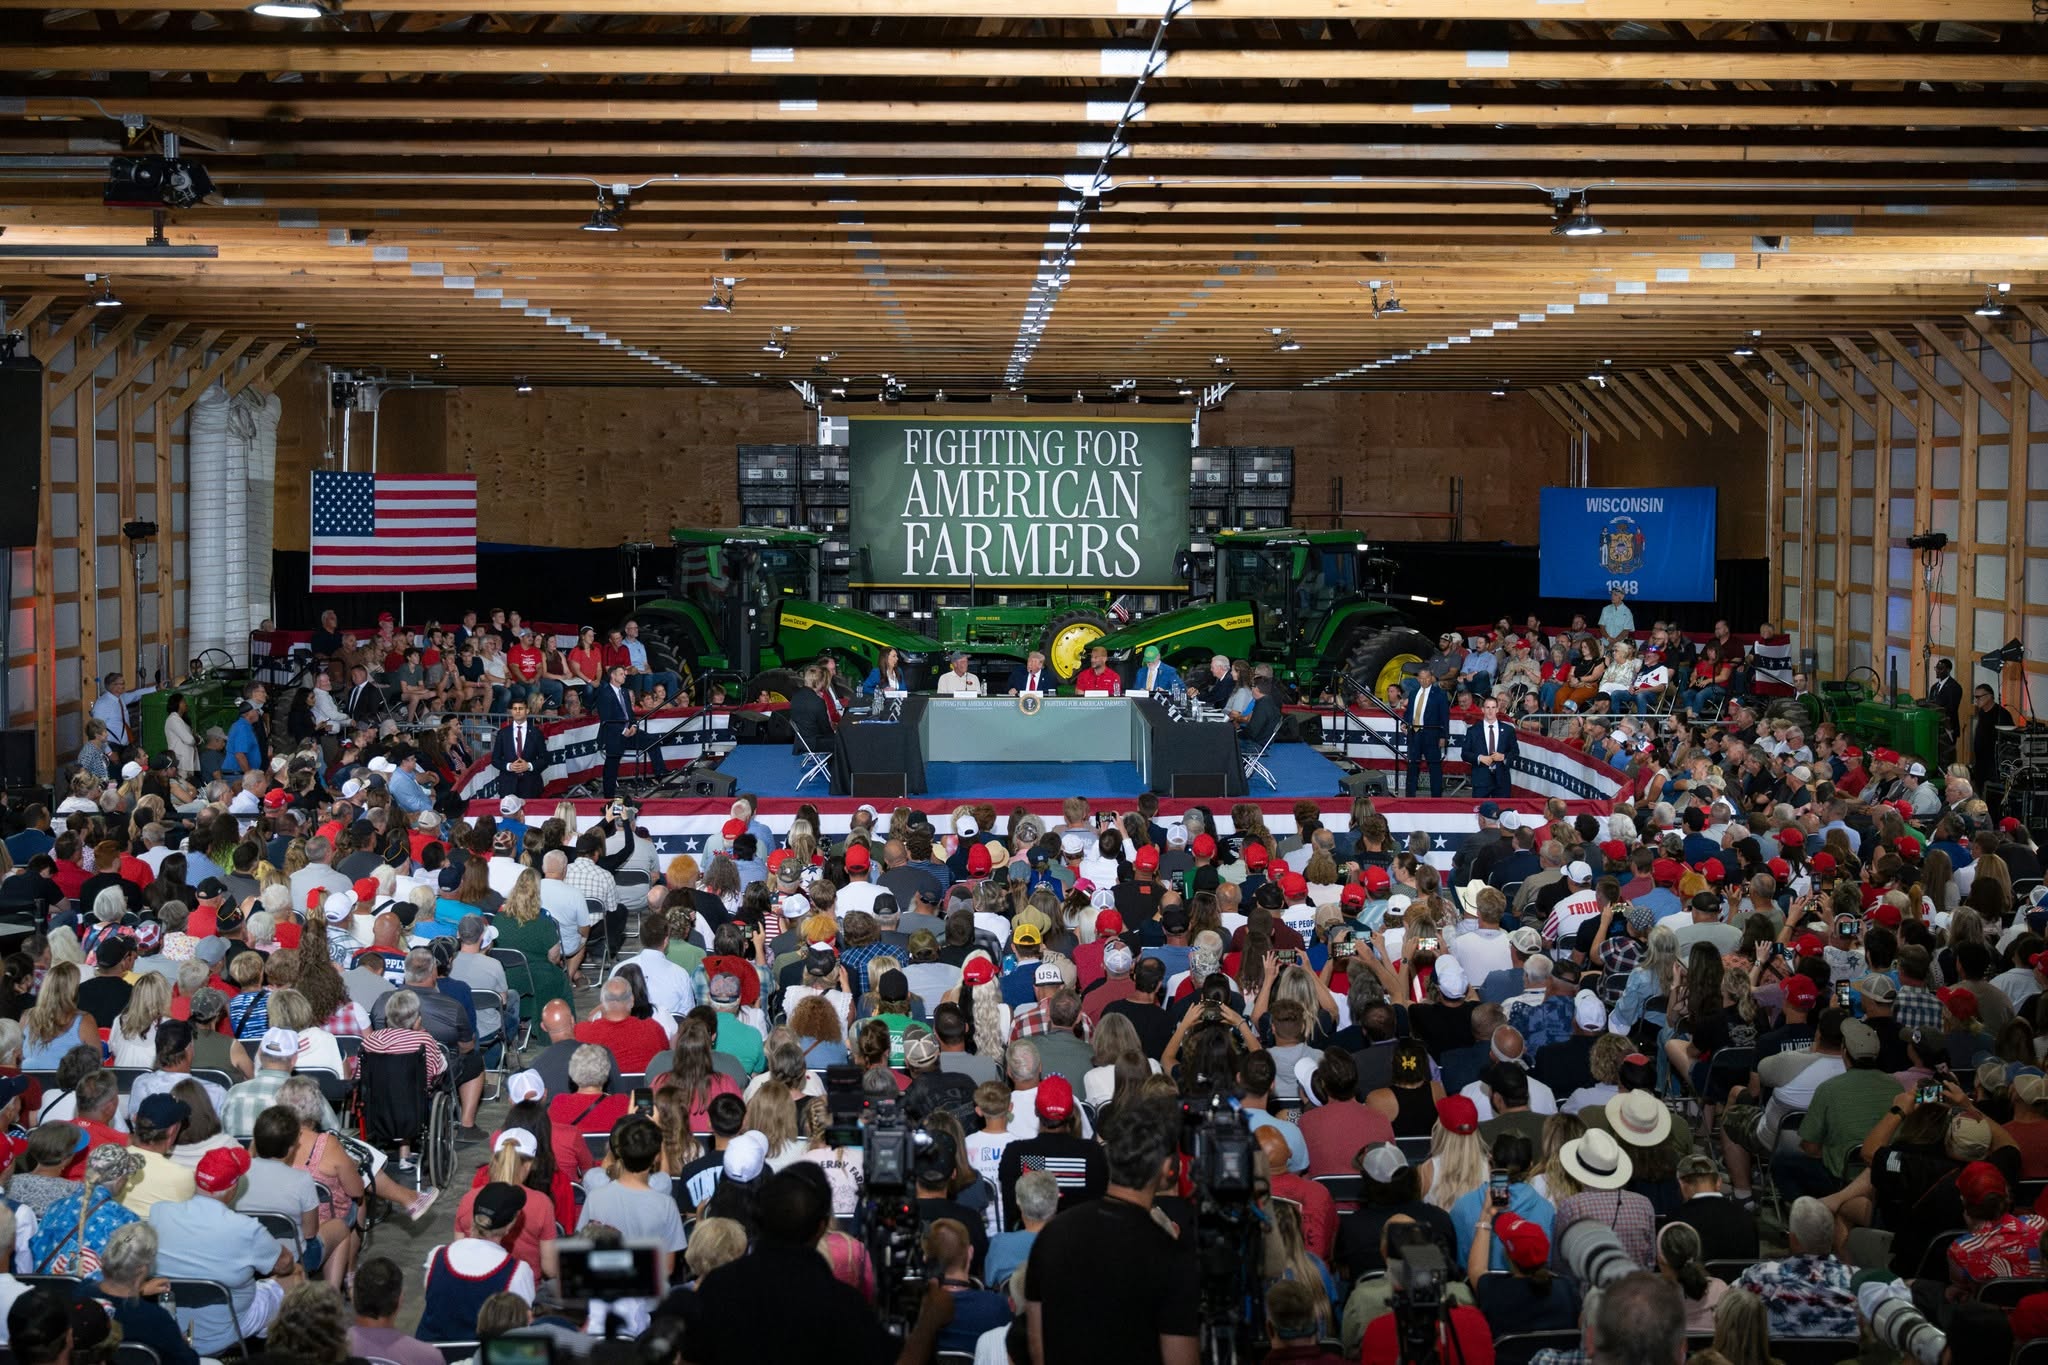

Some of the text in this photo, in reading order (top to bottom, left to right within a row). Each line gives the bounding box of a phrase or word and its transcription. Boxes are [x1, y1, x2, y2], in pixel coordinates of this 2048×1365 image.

[904, 429, 1142, 467] FIGHTING FOR
[901, 469, 1142, 519] AMERICAN
[1586, 498, 1663, 513] WISCONSIN
[902, 522, 1141, 579] FARMERS
[1567, 901, 1601, 915] TRU
[1299, 919, 1315, 928] PEOP
[1038, 971, 1059, 980] USA
[967, 1147, 1000, 1161] TRU
[820, 1160, 864, 1184] ERRY FAR
